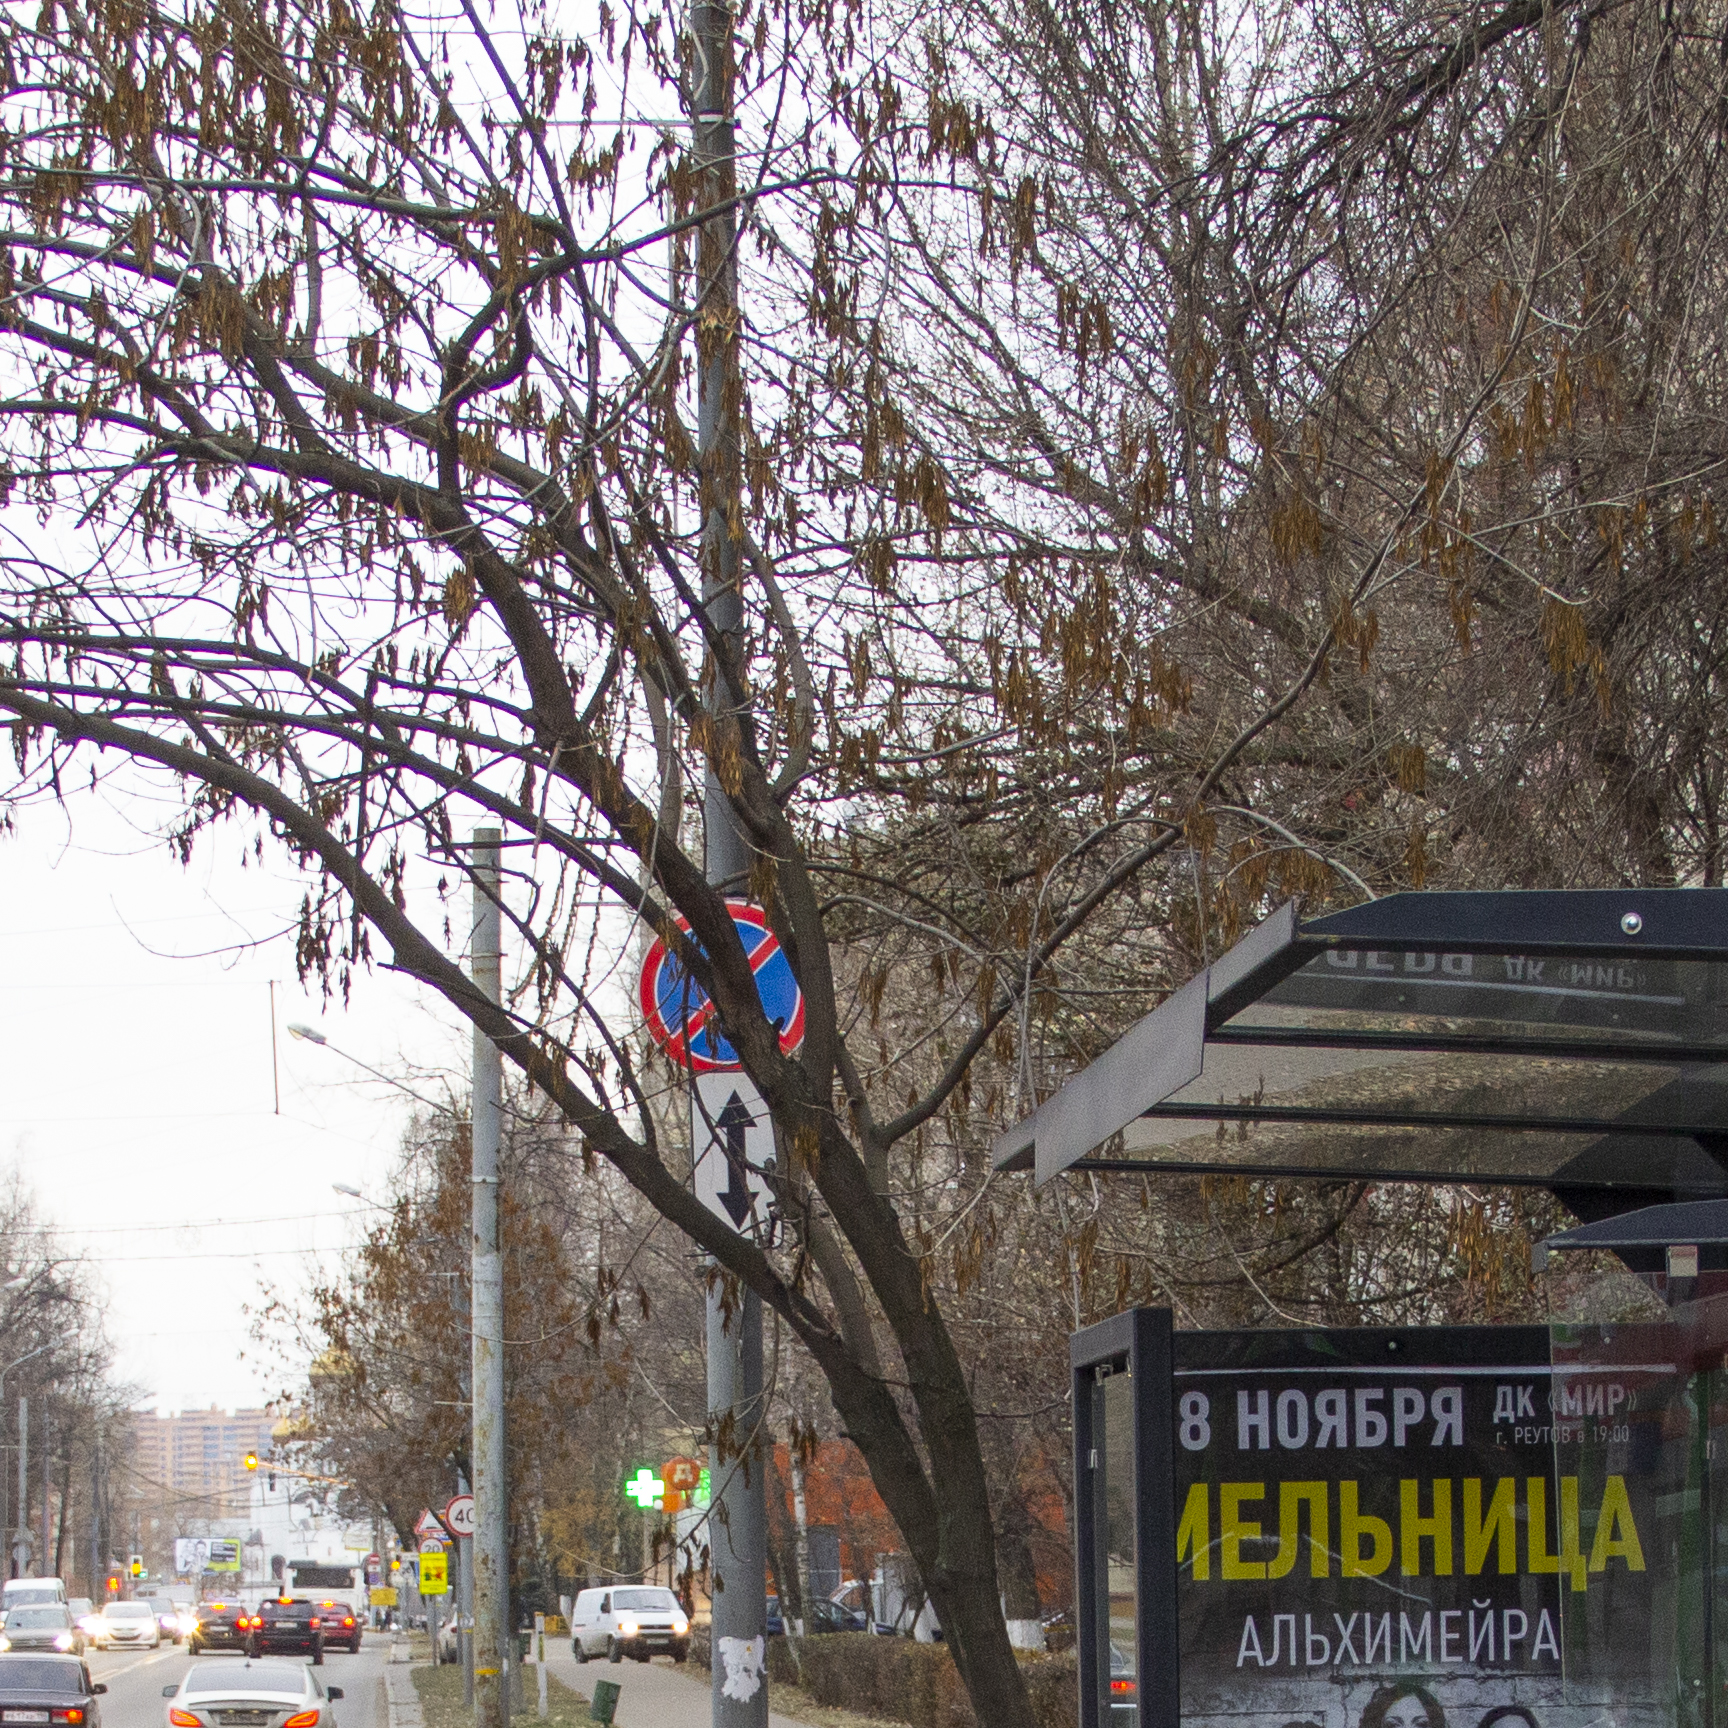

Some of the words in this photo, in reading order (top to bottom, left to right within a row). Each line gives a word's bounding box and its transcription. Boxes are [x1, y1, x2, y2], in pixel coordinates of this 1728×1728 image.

[1178, 1391, 1211, 1452] 8
[1237, 1386, 1464, 1450] НОЯБРЯ
[1492, 1385, 1536, 1424] ДК
[1514, 1425, 1572, 1445] РЕУТОВ
[1593, 1425, 1630, 1444] 19:00
[454, 1507, 474, 1524] 40
[1237, 1598, 1560, 1667] АЛЬХИМЕЙРА
